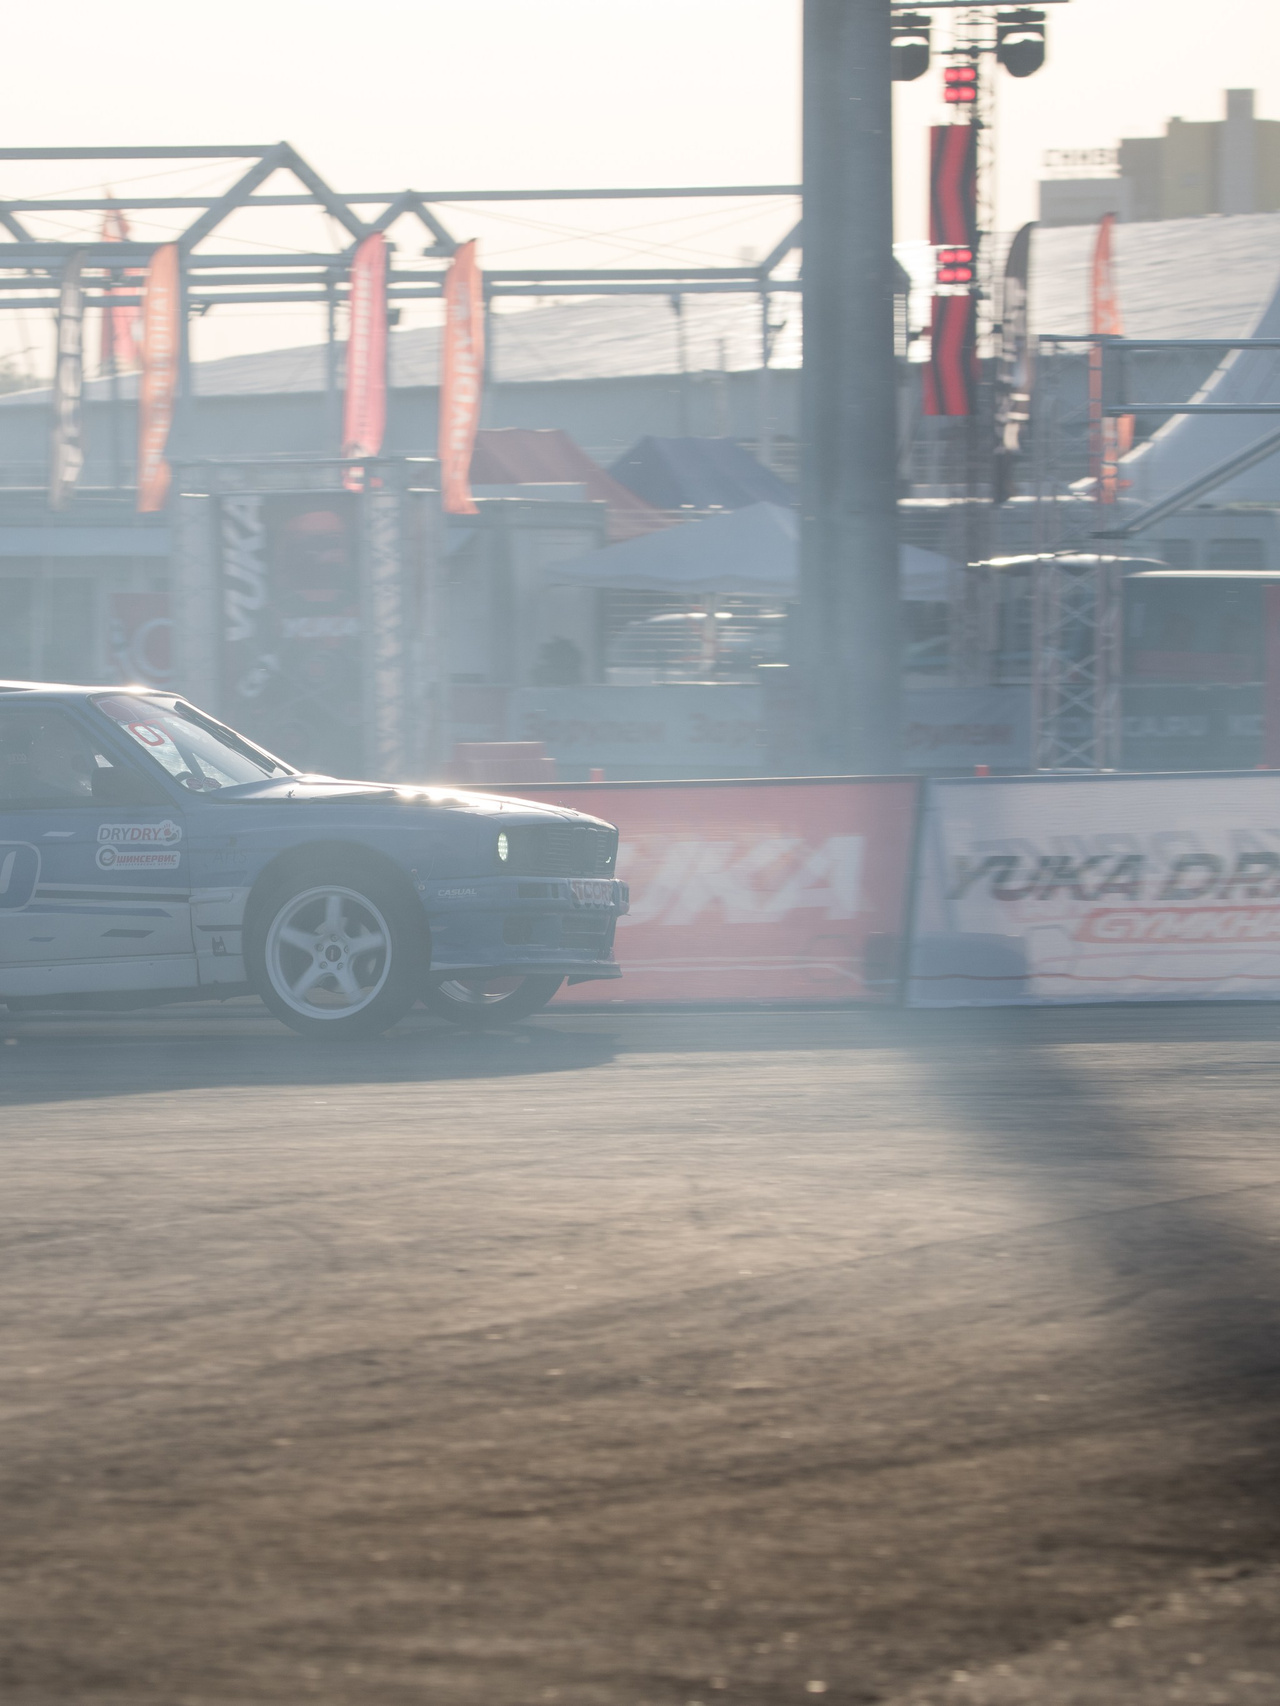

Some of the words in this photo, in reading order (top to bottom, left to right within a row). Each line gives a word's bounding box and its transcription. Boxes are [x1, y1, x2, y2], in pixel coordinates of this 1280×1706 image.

[223, 495, 266, 641] YUKA
[99, 828, 161, 841] DRYDRY
[116, 855, 177, 863] ШИНСЕРВИС
[437, 887, 478, 897] CASUAL
[618, 832, 870, 927] UKA
[947, 854, 1148, 901] YUKA
